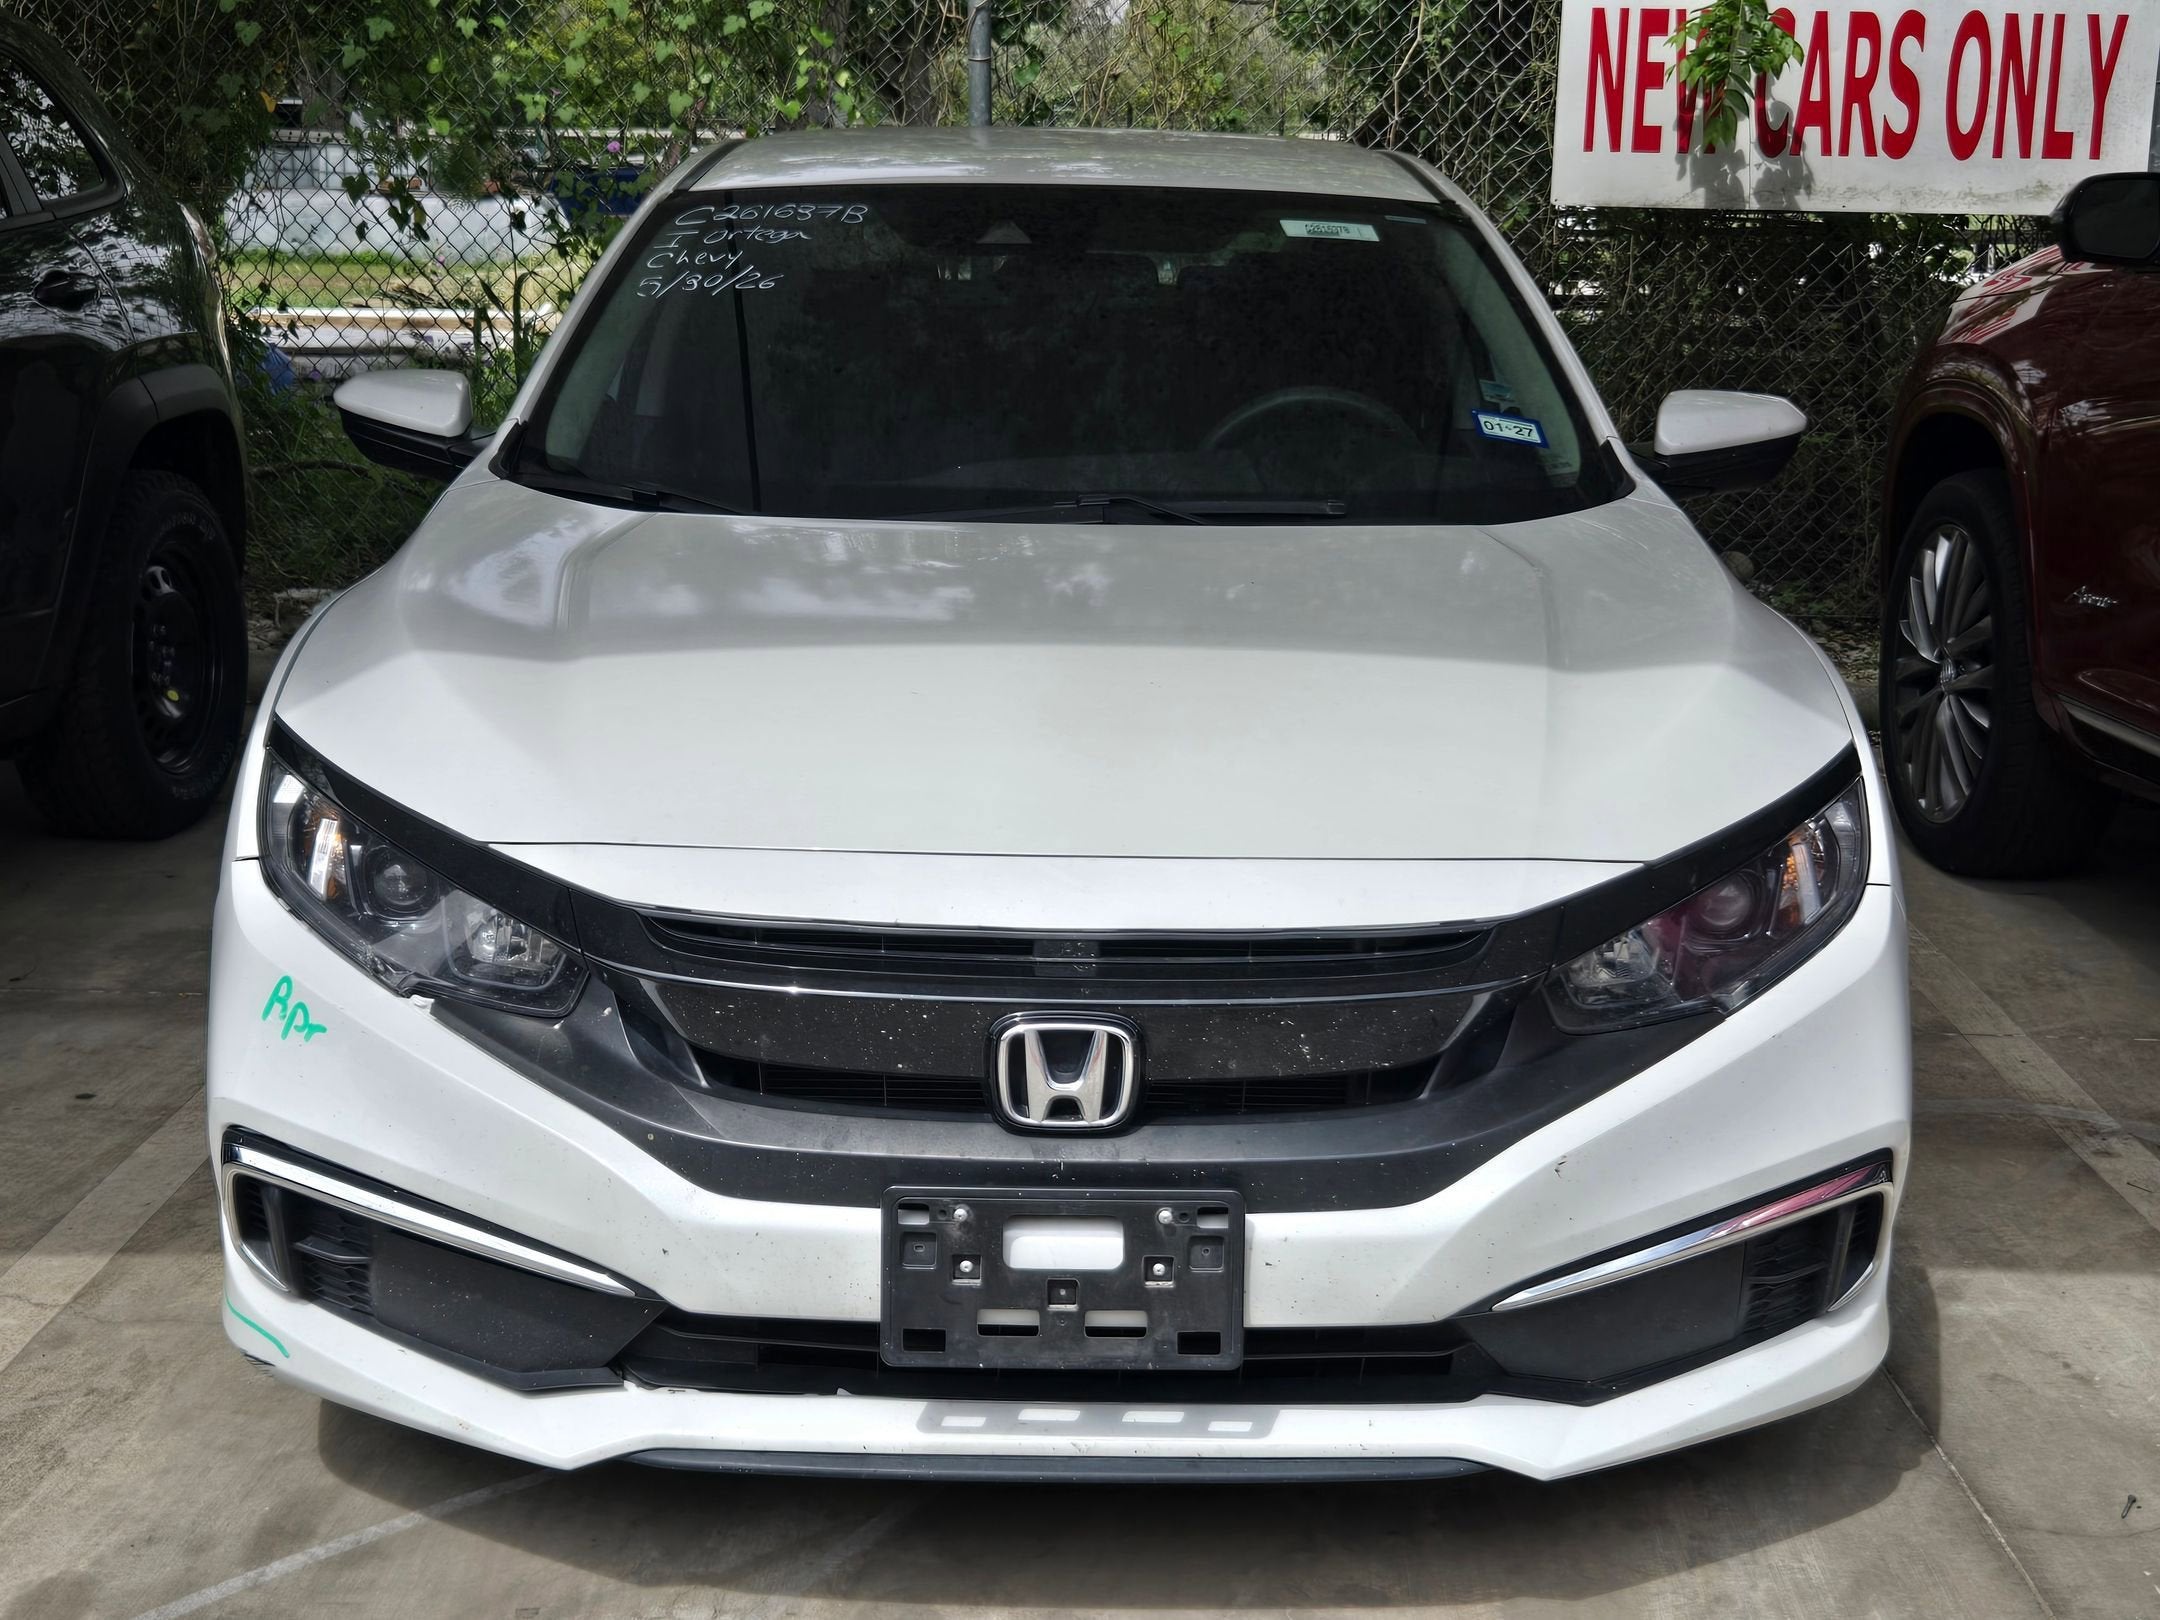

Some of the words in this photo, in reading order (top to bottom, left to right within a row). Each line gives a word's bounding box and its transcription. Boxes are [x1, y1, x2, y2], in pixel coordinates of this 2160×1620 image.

[1754, 8, 1926, 160] CARS
[1945, 10, 2130, 161] ONLY
[647, 250, 743, 270] Chevy
[637, 265, 784, 299] 5/30/26
